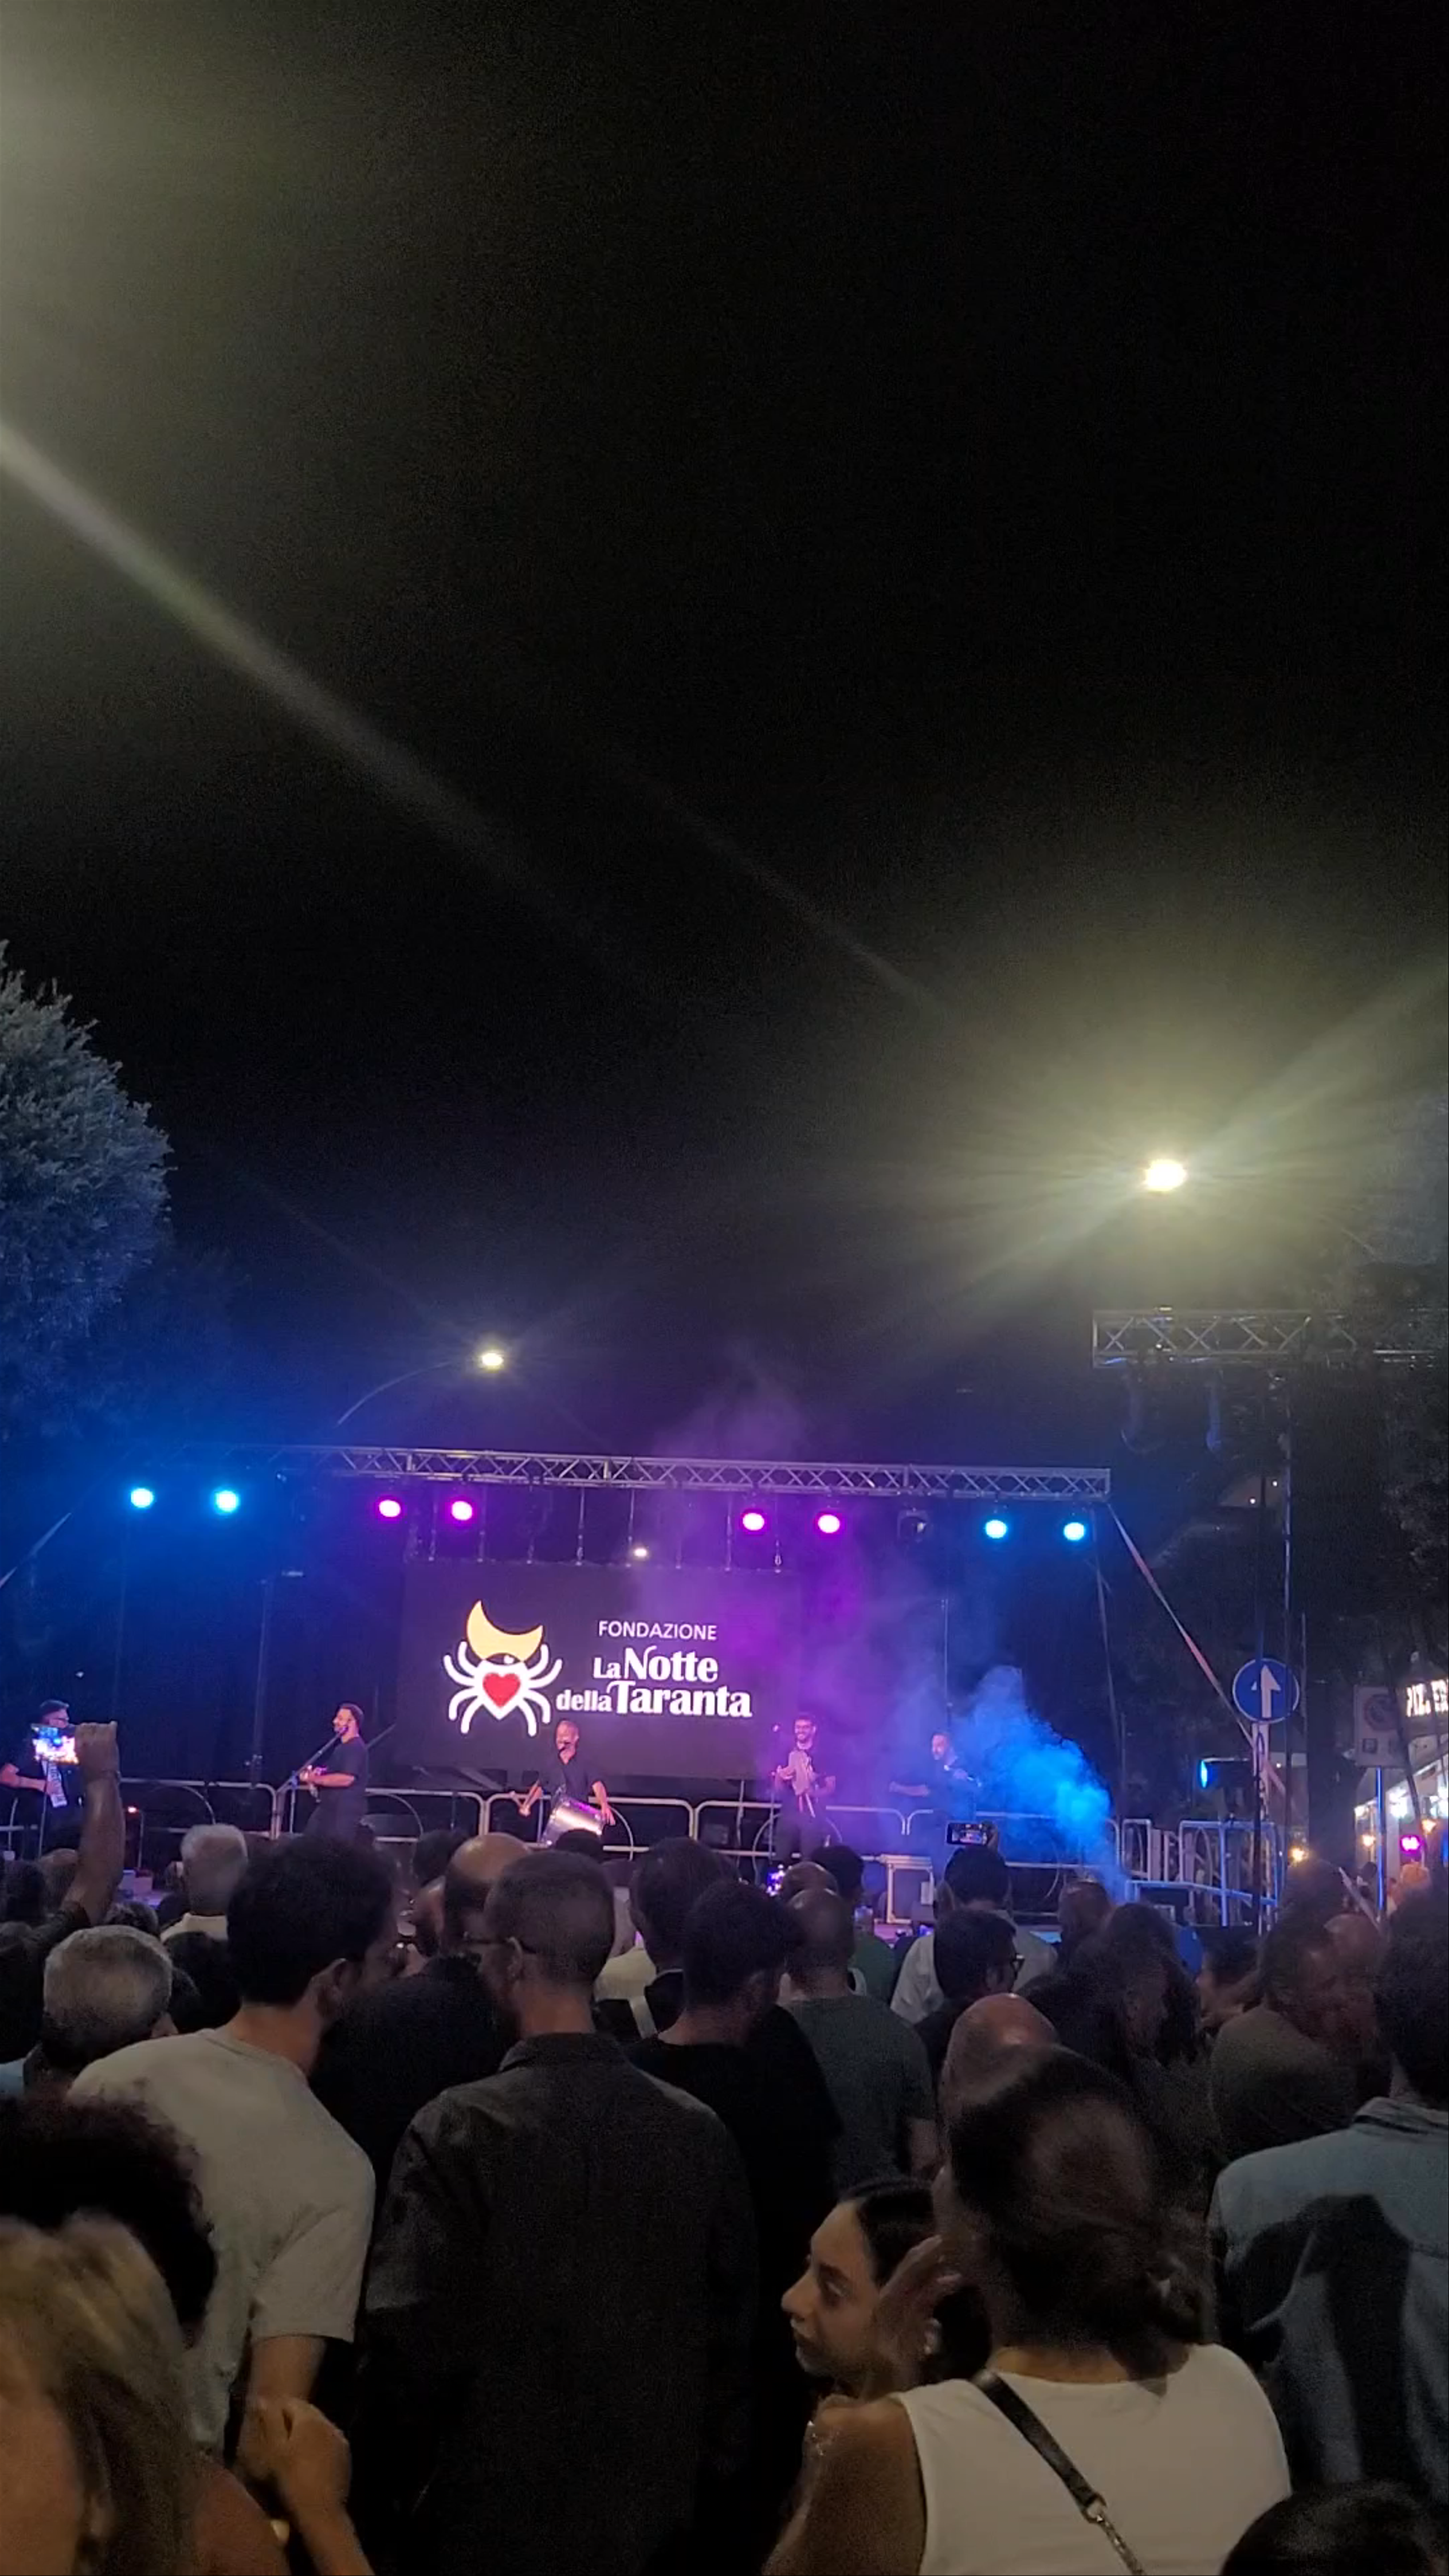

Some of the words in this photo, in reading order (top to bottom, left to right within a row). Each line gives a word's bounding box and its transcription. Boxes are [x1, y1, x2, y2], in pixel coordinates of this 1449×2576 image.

[598, 1620, 717, 1640] FONDAZIONE
[593, 1657, 622, 1679] La
[624, 1645, 718, 1683] Notte
[556, 1689, 612, 1712] della
[606, 1680, 752, 1718] Taranta
